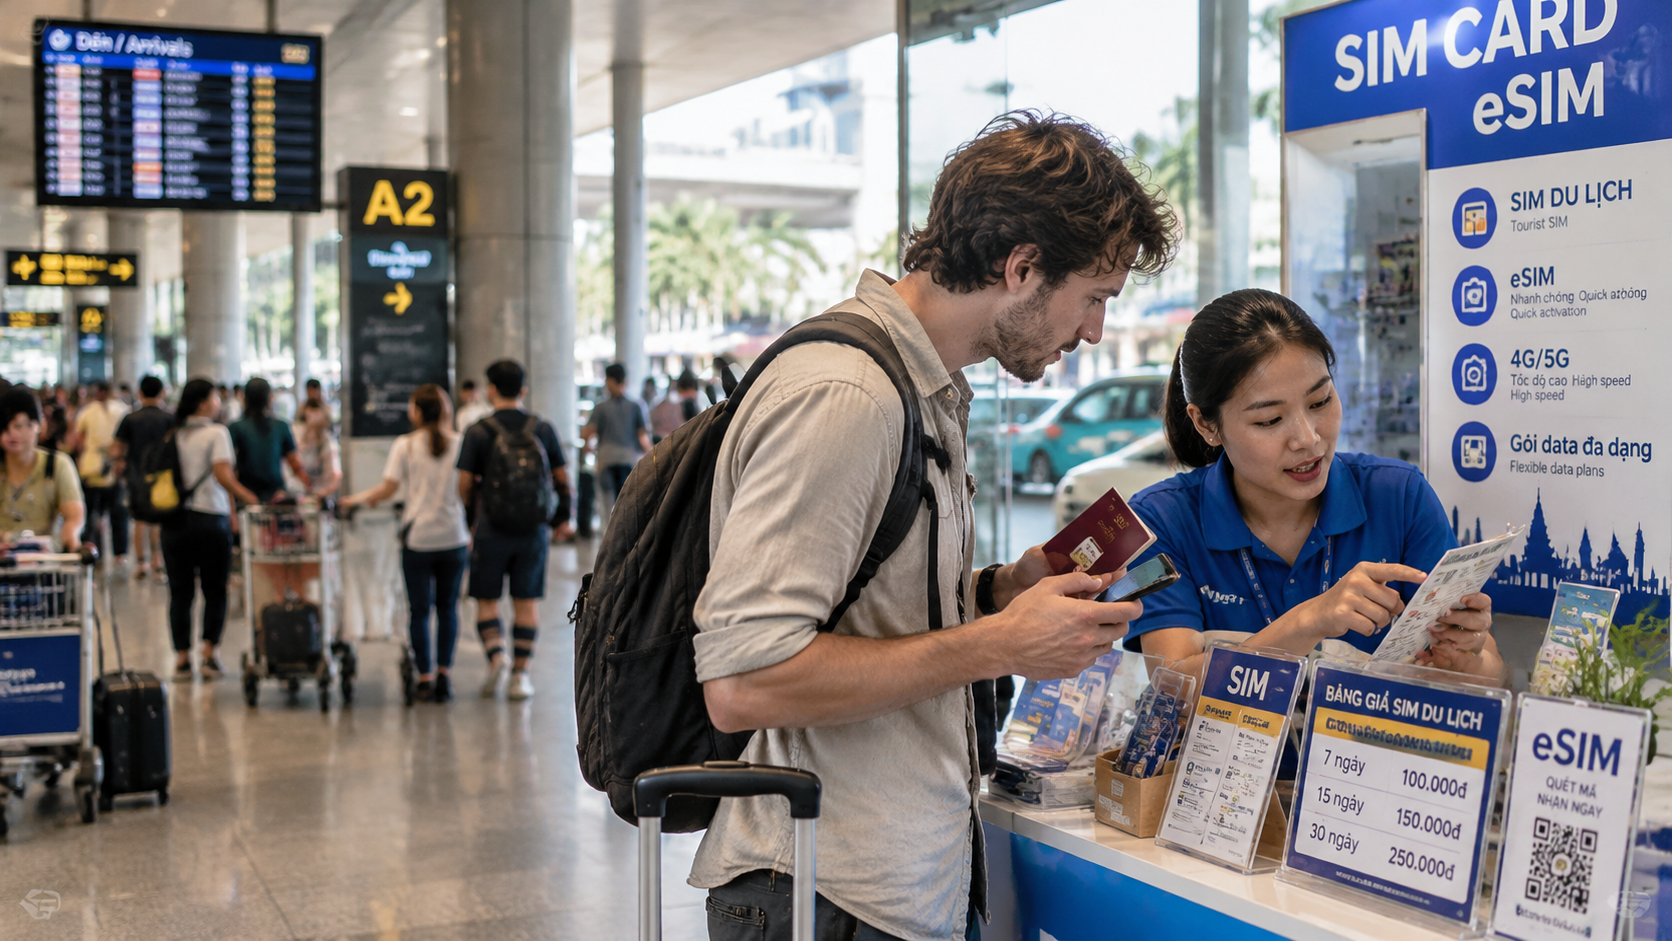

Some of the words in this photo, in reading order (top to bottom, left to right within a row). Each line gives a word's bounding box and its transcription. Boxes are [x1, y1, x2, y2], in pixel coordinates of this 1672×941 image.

[1334, 18, 1428, 92] SIM
[1443, 0, 1618, 69] CARD
[1472, 61, 1605, 135] eSIM
[363, 179, 436, 226] A2
[1511, 189, 1544, 212] SIM
[1551, 185, 1579, 207] DU
[1585, 178, 1633, 208] LỊCH
[1511, 217, 1546, 232] Tourist
[1548, 215, 1568, 229] SIM
[1510, 266, 1555, 288] eSIM
[1510, 293, 1542, 305] Nhanh
[1510, 307, 1538, 320] Quick
[1510, 348, 1570, 370] 4G/5G
[1548, 377, 1568, 387] cao
[1600, 374, 1632, 389] speed
[1535, 390, 1565, 403] speed
[1541, 435, 1579, 455] data
[1582, 436, 1604, 456] đa
[1608, 437, 1652, 463] dạng
[1510, 460, 1548, 473] Flexible
[1550, 462, 1574, 475] data
[1576, 464, 1605, 478] plans
[1227, 665, 1270, 701] SIM
[1365, 690, 1390, 713] GIÁ
[1392, 698, 1419, 719] SIM
[1421, 703, 1444, 723] DU
[1447, 708, 1484, 731] LỊCH
[1532, 728, 1623, 776] eSIM
[1324, 749, 1332, 766] 7
[1402, 769, 1468, 800] 100.000đ
[1546, 776, 1577, 793] QUÉT
[1317, 786, 1331, 804] 15
[1396, 808, 1462, 841] 150.000đ
[1571, 801, 1604, 819] NGAY
[1309, 823, 1326, 842] 30
[1388, 847, 1456, 882] 250.000đ
